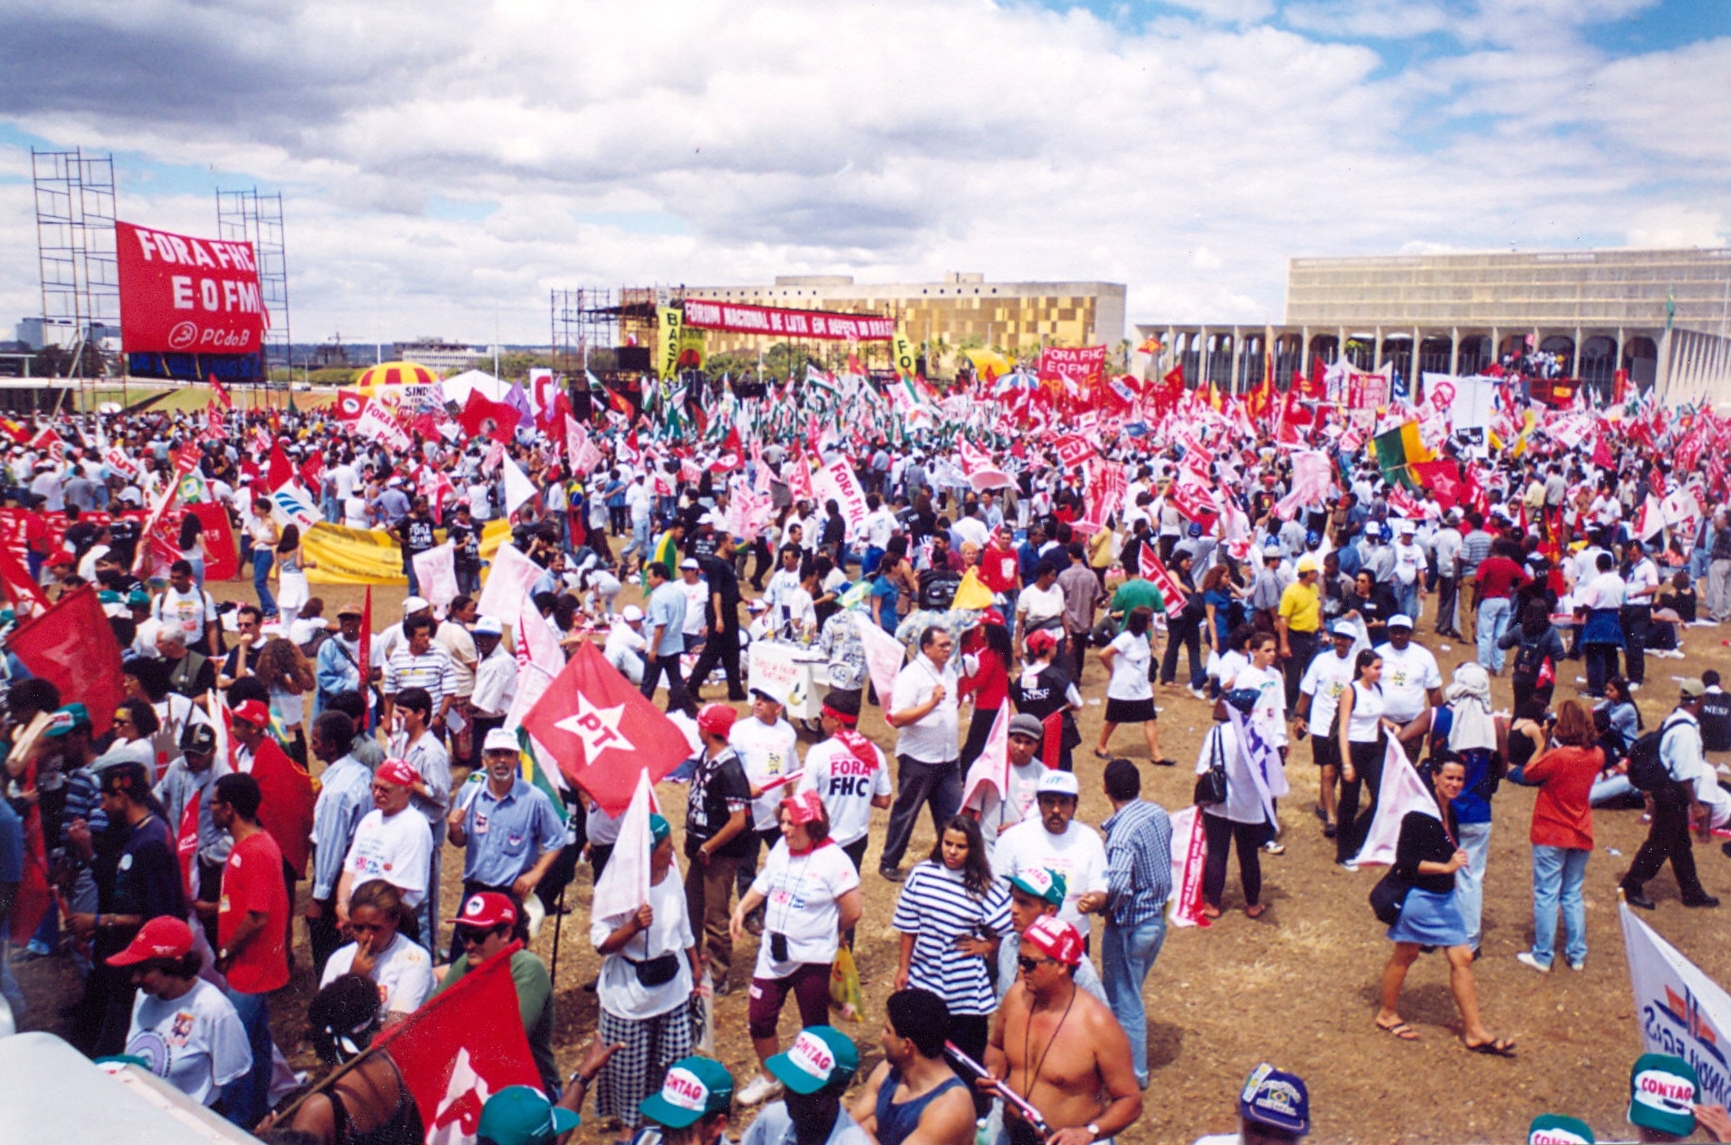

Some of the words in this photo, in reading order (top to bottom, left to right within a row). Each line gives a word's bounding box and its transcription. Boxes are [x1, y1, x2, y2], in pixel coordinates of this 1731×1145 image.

[134, 228, 216, 268] FORA
[208, 240, 256, 272] FHC
[171, 274, 195, 310] E
[200, 277, 219, 312] O
[222, 279, 262, 315] FMI
[576, 712, 618, 748] PT
[831, 761, 871, 776] FORA
[829, 776, 870, 798] FHC
[1641, 1076, 1693, 1102] CONTAG
